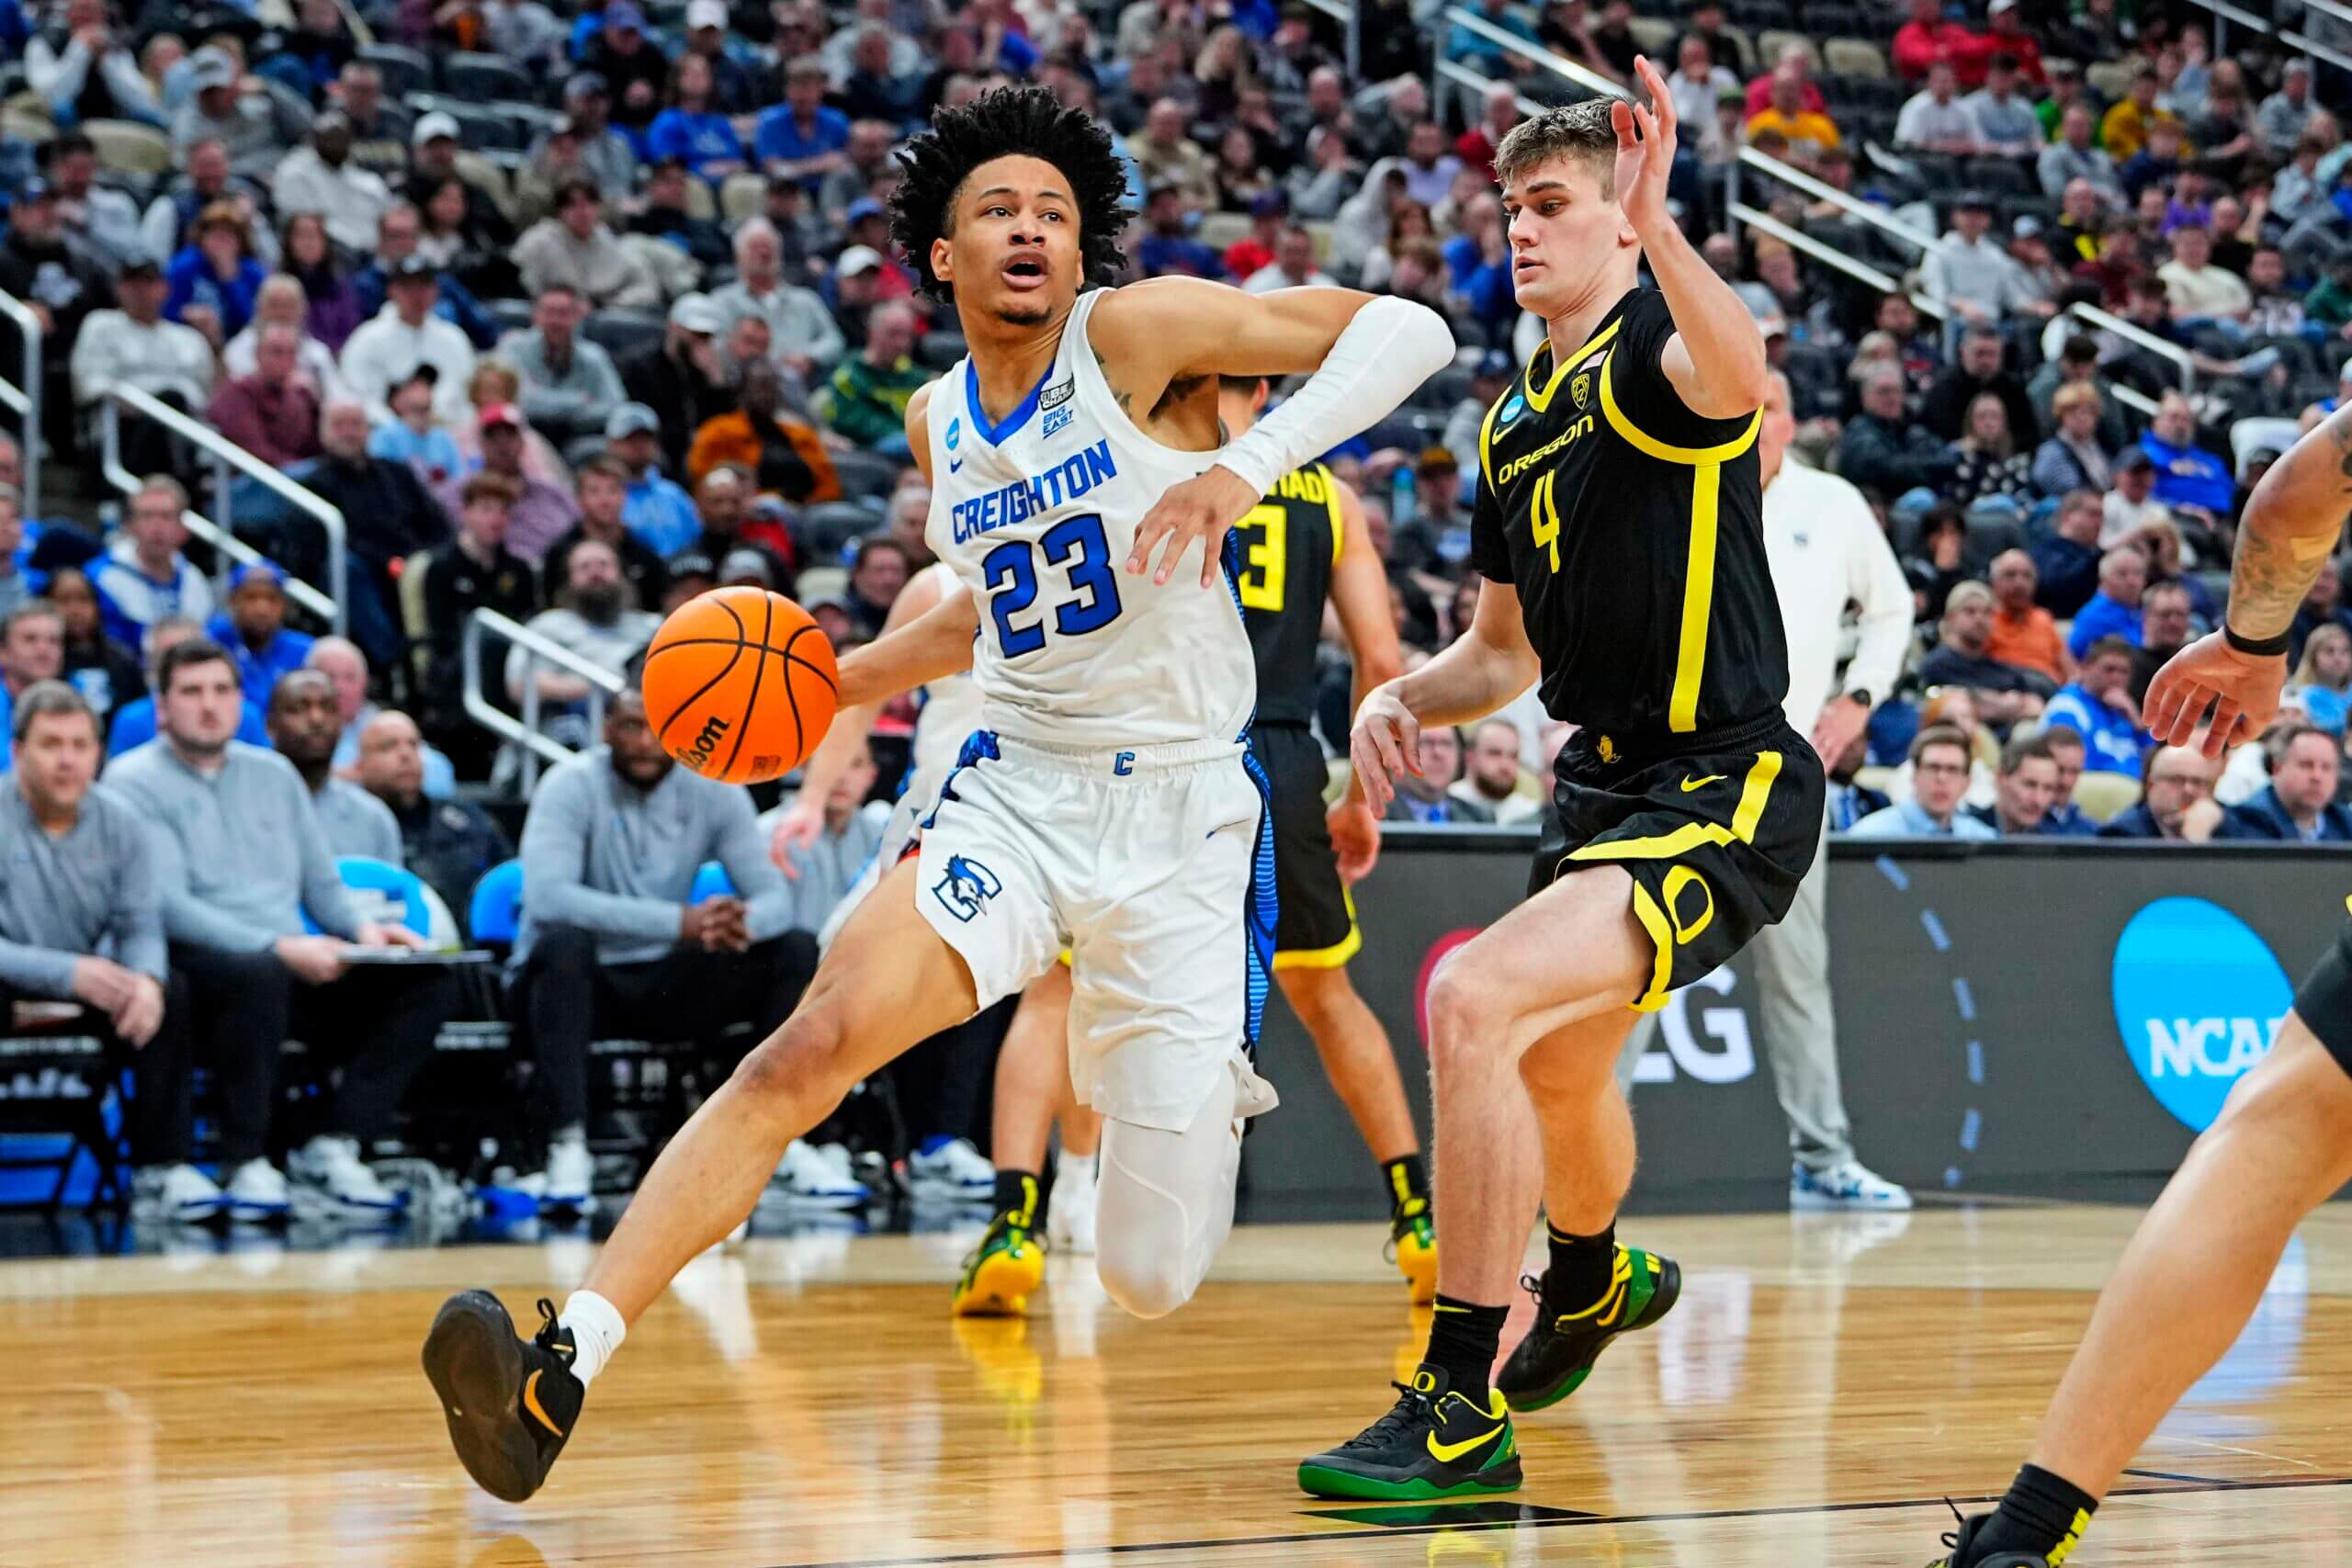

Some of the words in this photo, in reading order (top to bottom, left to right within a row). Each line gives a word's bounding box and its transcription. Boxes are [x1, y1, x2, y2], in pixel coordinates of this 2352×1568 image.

[1044, 405, 1066, 423] BIG
[1044, 410, 1074, 434] EAST
[1498, 414, 1594, 485] OREGON
[952, 438, 1118, 545] CREIGHTON
[1531, 468, 1560, 574] 4
[981, 512, 1124, 660] 23
[1233, 504, 1287, 613] 3
[1113, 751, 1136, 776] C
[1662, 864, 1714, 945] O
[1413, 1371, 1436, 1393] O
